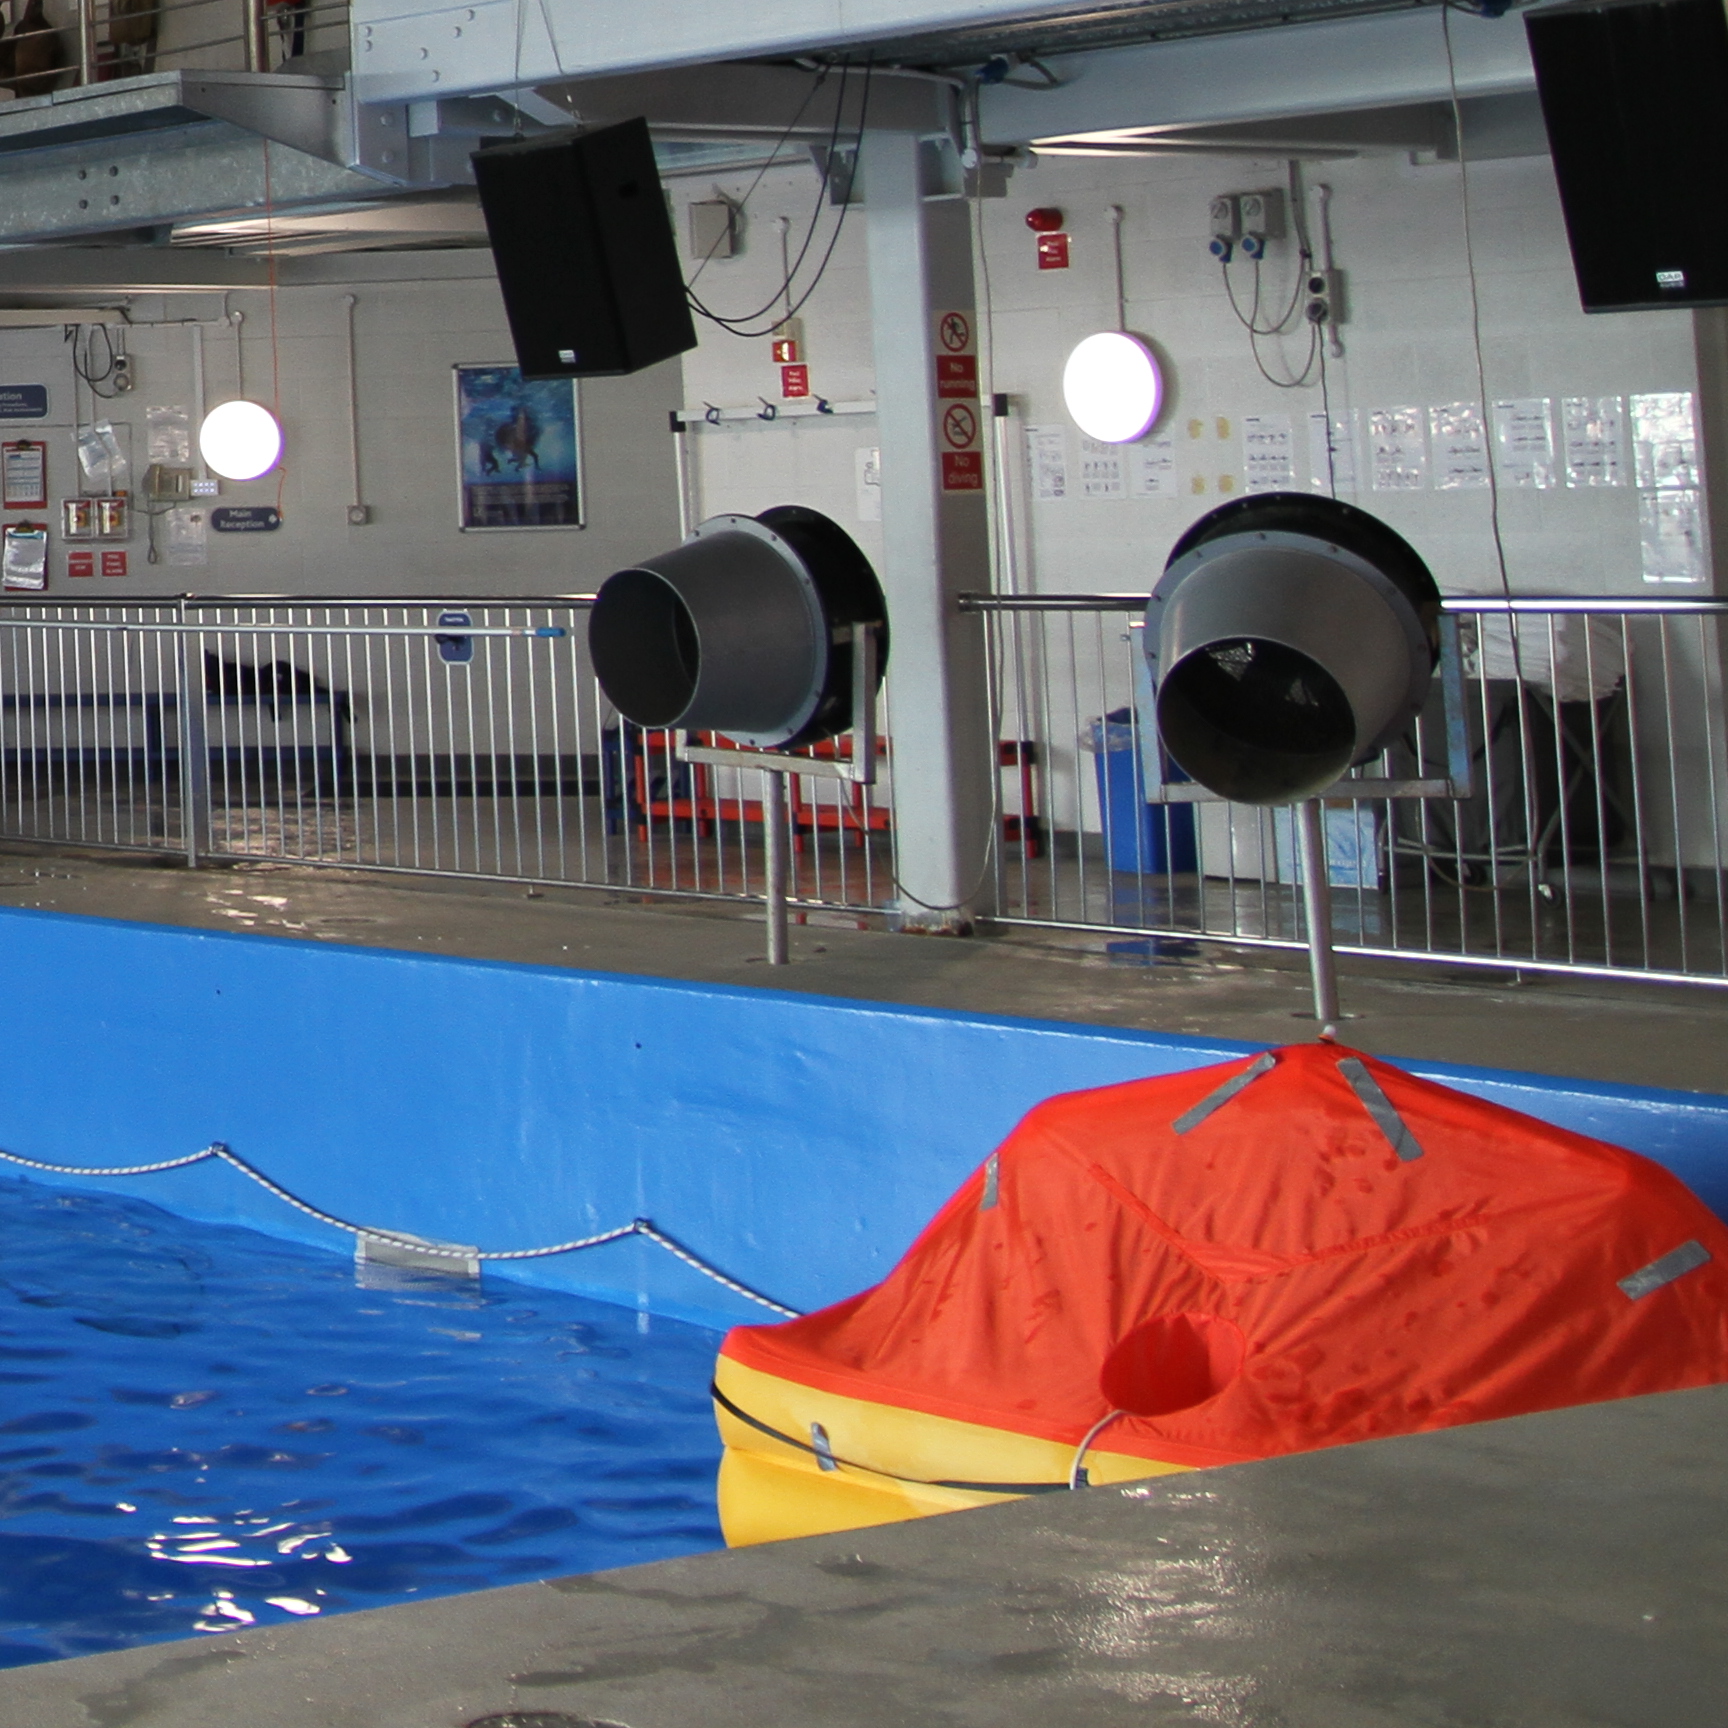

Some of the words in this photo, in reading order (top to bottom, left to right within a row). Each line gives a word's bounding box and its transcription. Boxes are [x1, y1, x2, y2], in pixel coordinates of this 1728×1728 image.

[950, 361, 964, 373] No
[940, 378, 975, 392] running
[954, 455, 970, 467] No
[948, 474, 978, 487] diving
[229, 509, 252, 518] Main
[220, 519, 265, 530] Reception
